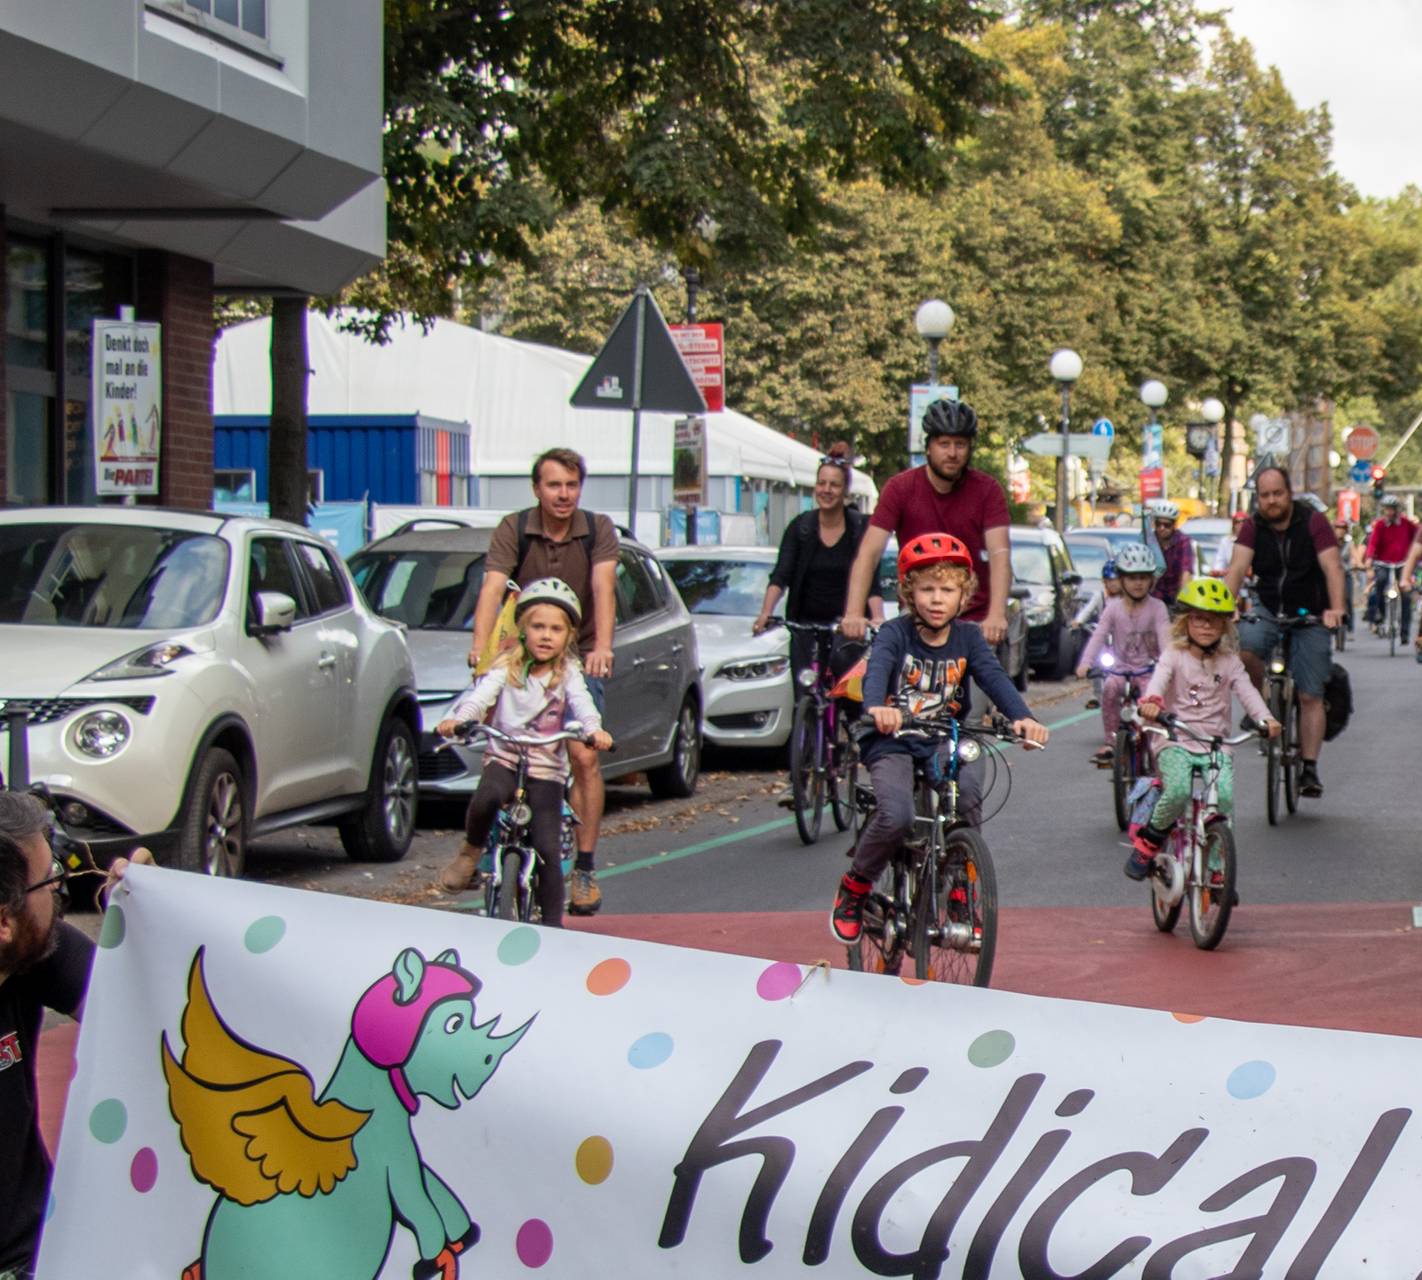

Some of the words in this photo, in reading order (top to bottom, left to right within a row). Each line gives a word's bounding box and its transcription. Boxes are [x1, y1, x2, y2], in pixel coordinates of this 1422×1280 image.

[105, 333, 131, 351] Denkt
[133, 335, 149, 352] doch
[106, 358, 122, 375] mal
[125, 363, 135, 376] an
[137, 359, 148, 376] die
[105, 381, 137, 399] Kinder!
[657, 1038, 1413, 1280] Kidical
